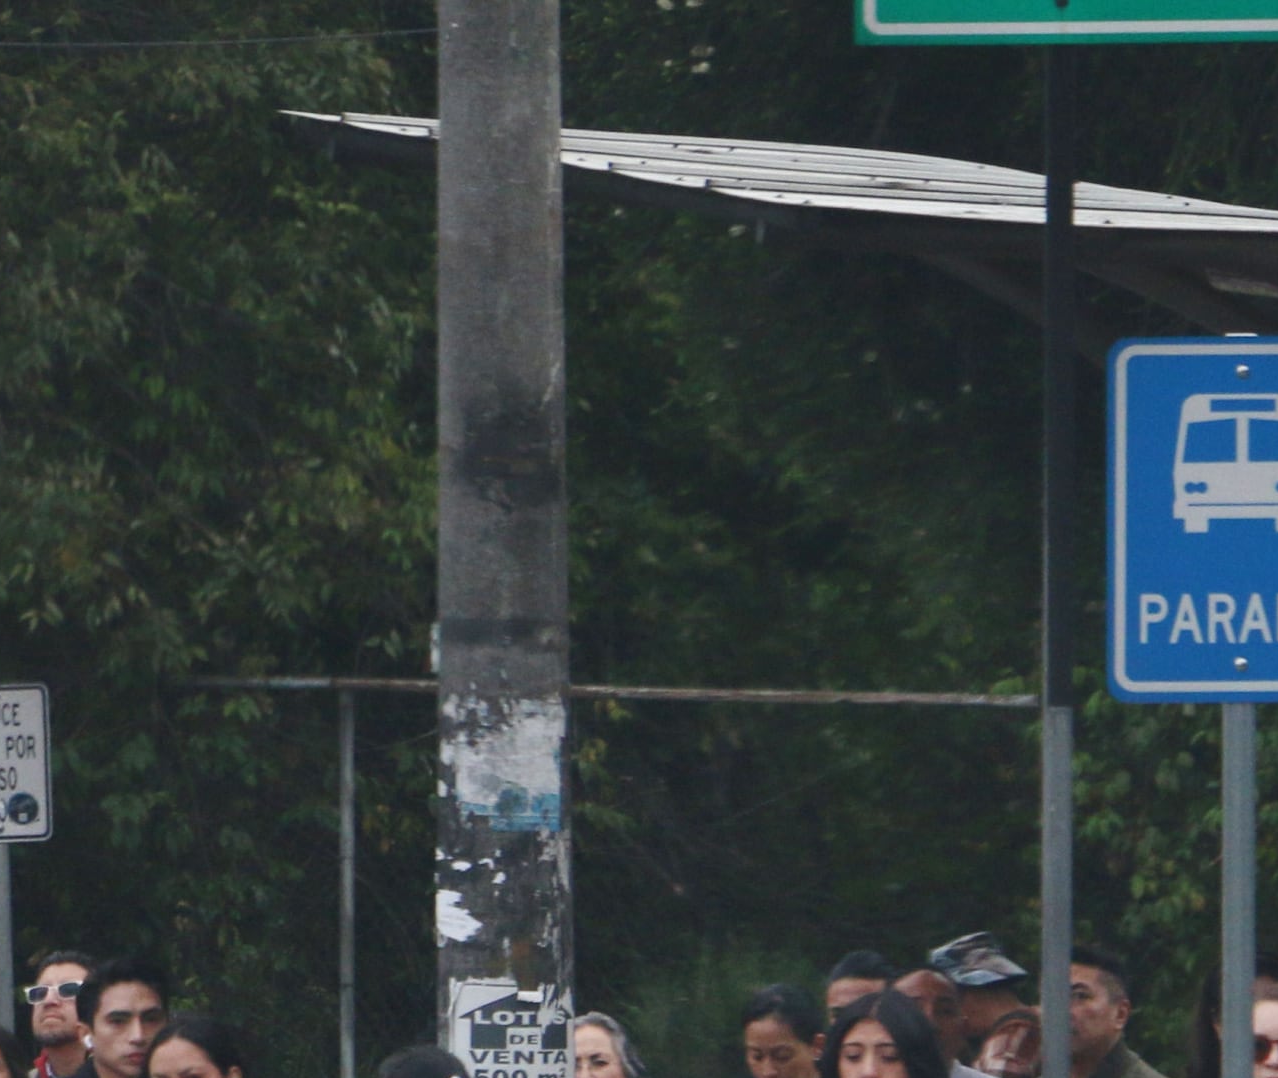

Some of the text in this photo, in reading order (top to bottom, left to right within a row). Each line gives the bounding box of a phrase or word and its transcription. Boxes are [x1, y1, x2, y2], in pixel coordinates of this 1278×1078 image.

[5, 735, 37, 761] POR
[473, 1009, 567, 1026] LOTS
[509, 1034, 539, 1045] DE
[470, 1050, 568, 1065] VENTA
